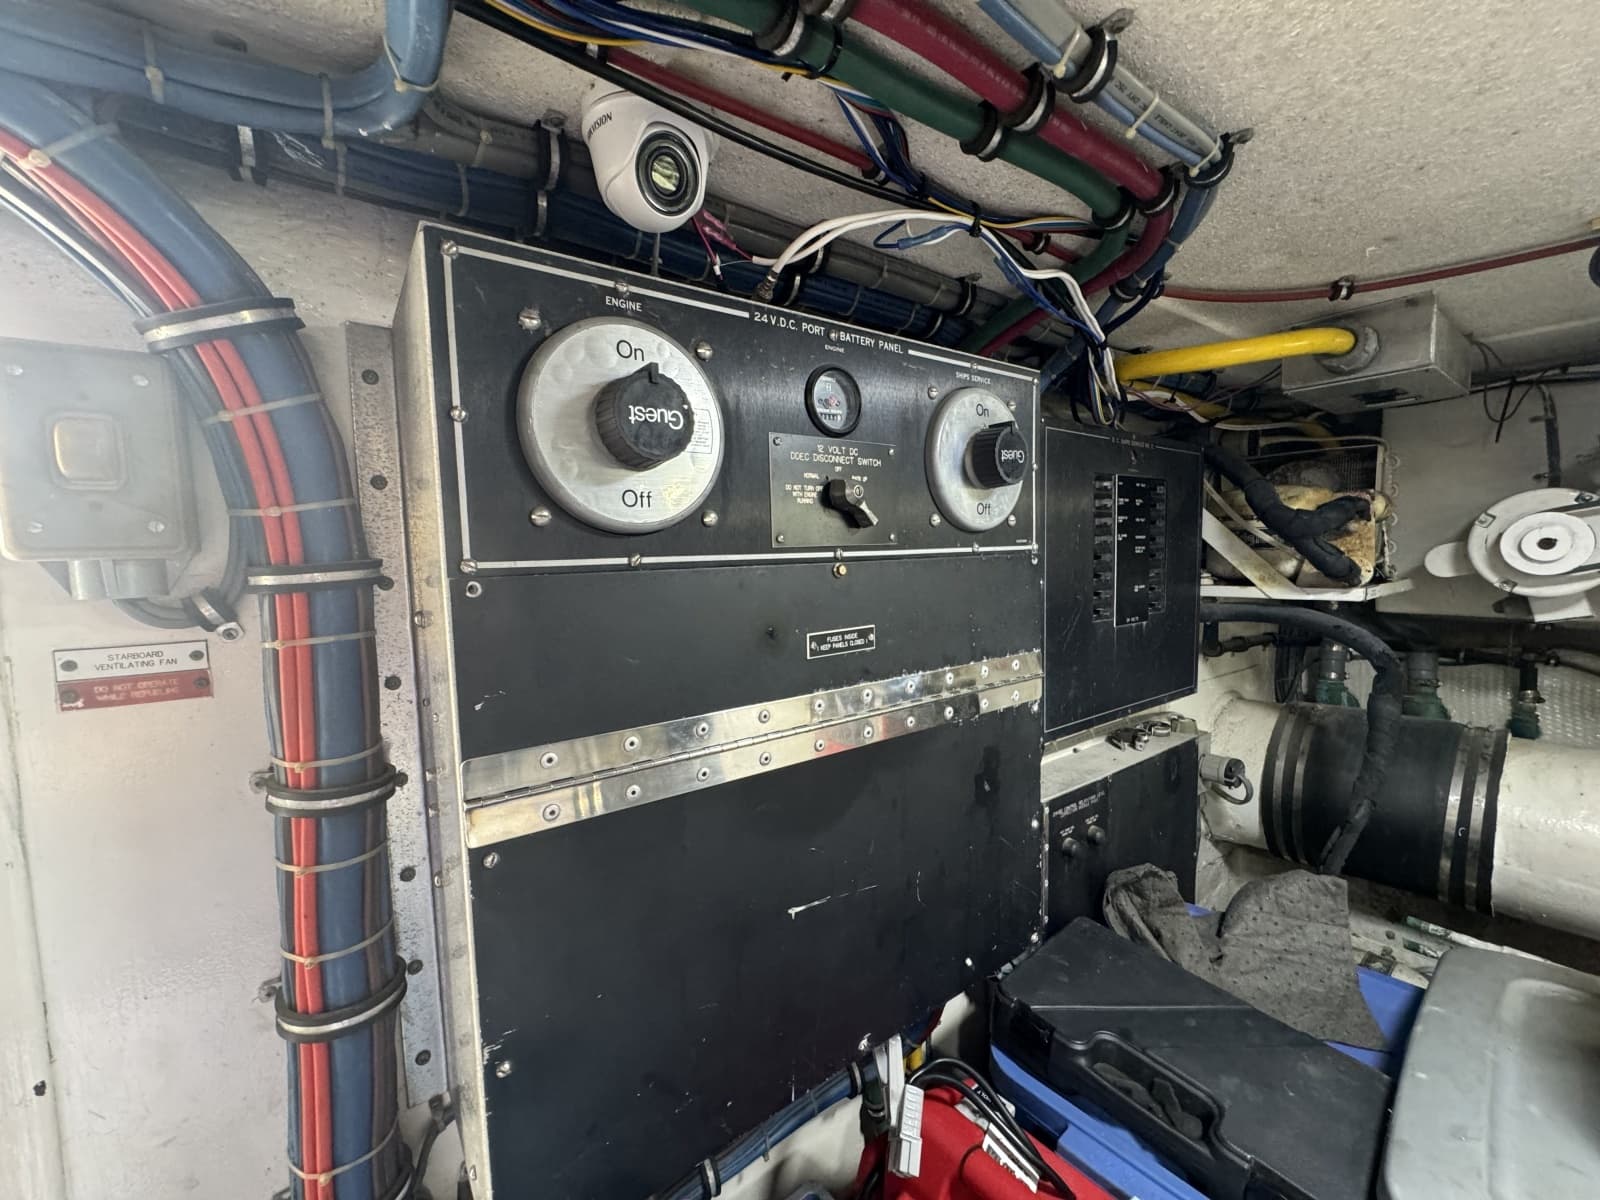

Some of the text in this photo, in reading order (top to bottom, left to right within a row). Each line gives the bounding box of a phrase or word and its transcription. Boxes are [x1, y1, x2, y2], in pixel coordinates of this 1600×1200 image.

[605, 295, 642, 312] ENGINE
[754, 311, 904, 354] 24 V.D.C. PORT BATTERY PANEL
[616, 339, 645, 362] On
[628, 404, 684, 430] Guest
[976, 403, 990, 417] On
[828, 446, 846, 455] VOLT
[849, 447, 859, 457] DC
[1001, 449, 1025, 464] Guest
[813, 453, 854, 465] DISCONNECT
[857, 457, 882, 468] SWITCH
[622, 489, 652, 508] Off
[976, 502, 992, 516] Off
[107, 650, 164, 662] STARBOARD
[94, 658, 178, 671] VENTILATING FAN
